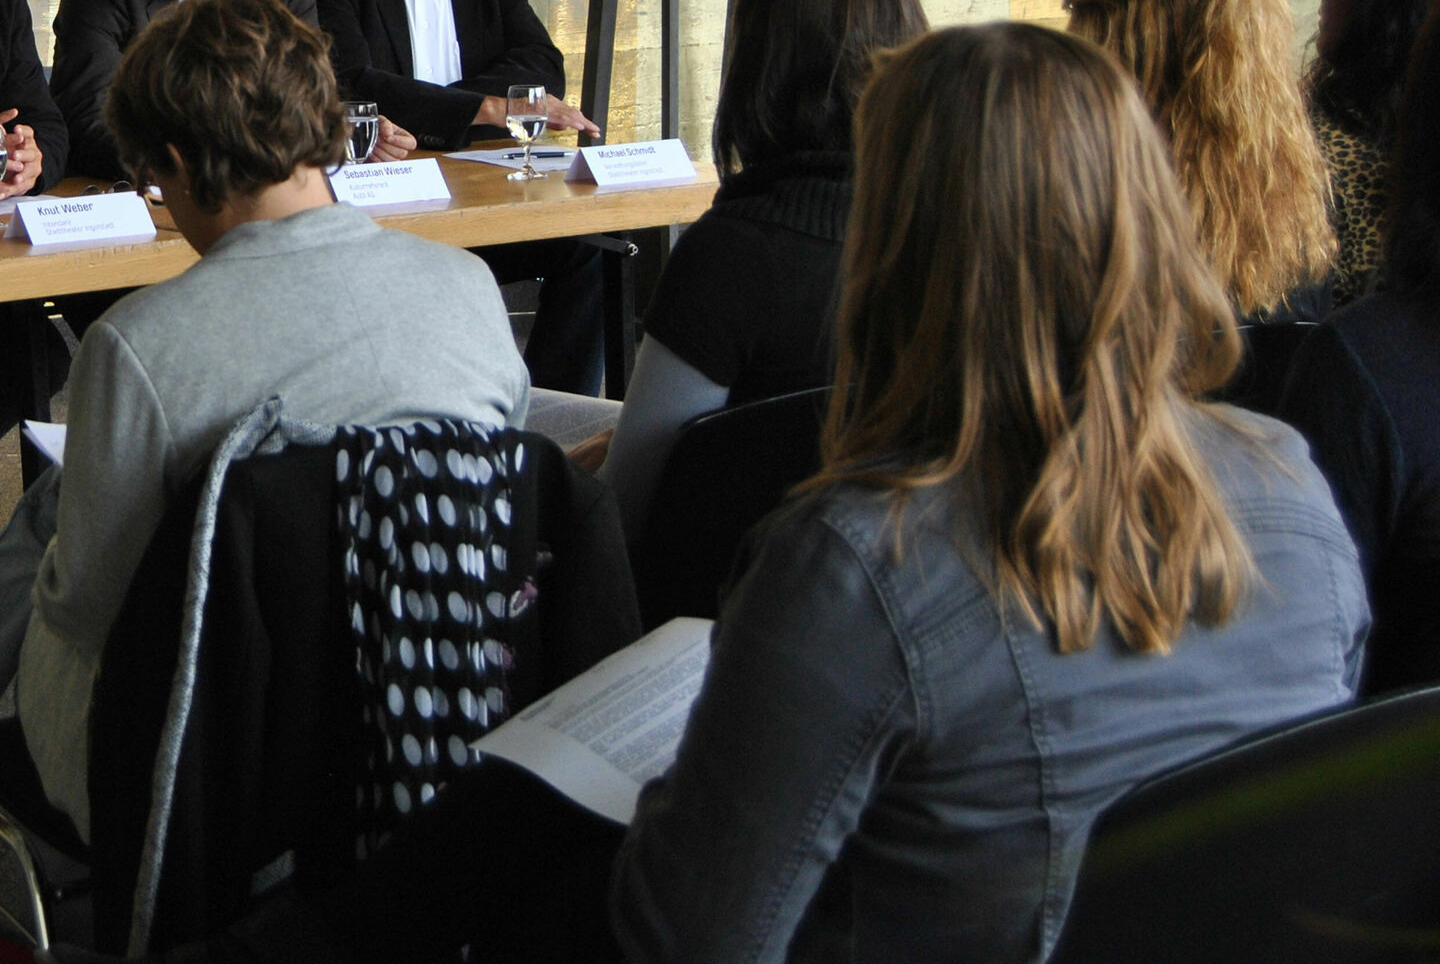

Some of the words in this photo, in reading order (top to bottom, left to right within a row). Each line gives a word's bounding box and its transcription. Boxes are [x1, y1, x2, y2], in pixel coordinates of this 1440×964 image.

[343, 168, 383, 179] Sebastian
[384, 165, 413, 175] Wieser
[37, 205, 60, 216] Knut
[60, 202, 93, 214] Weber
